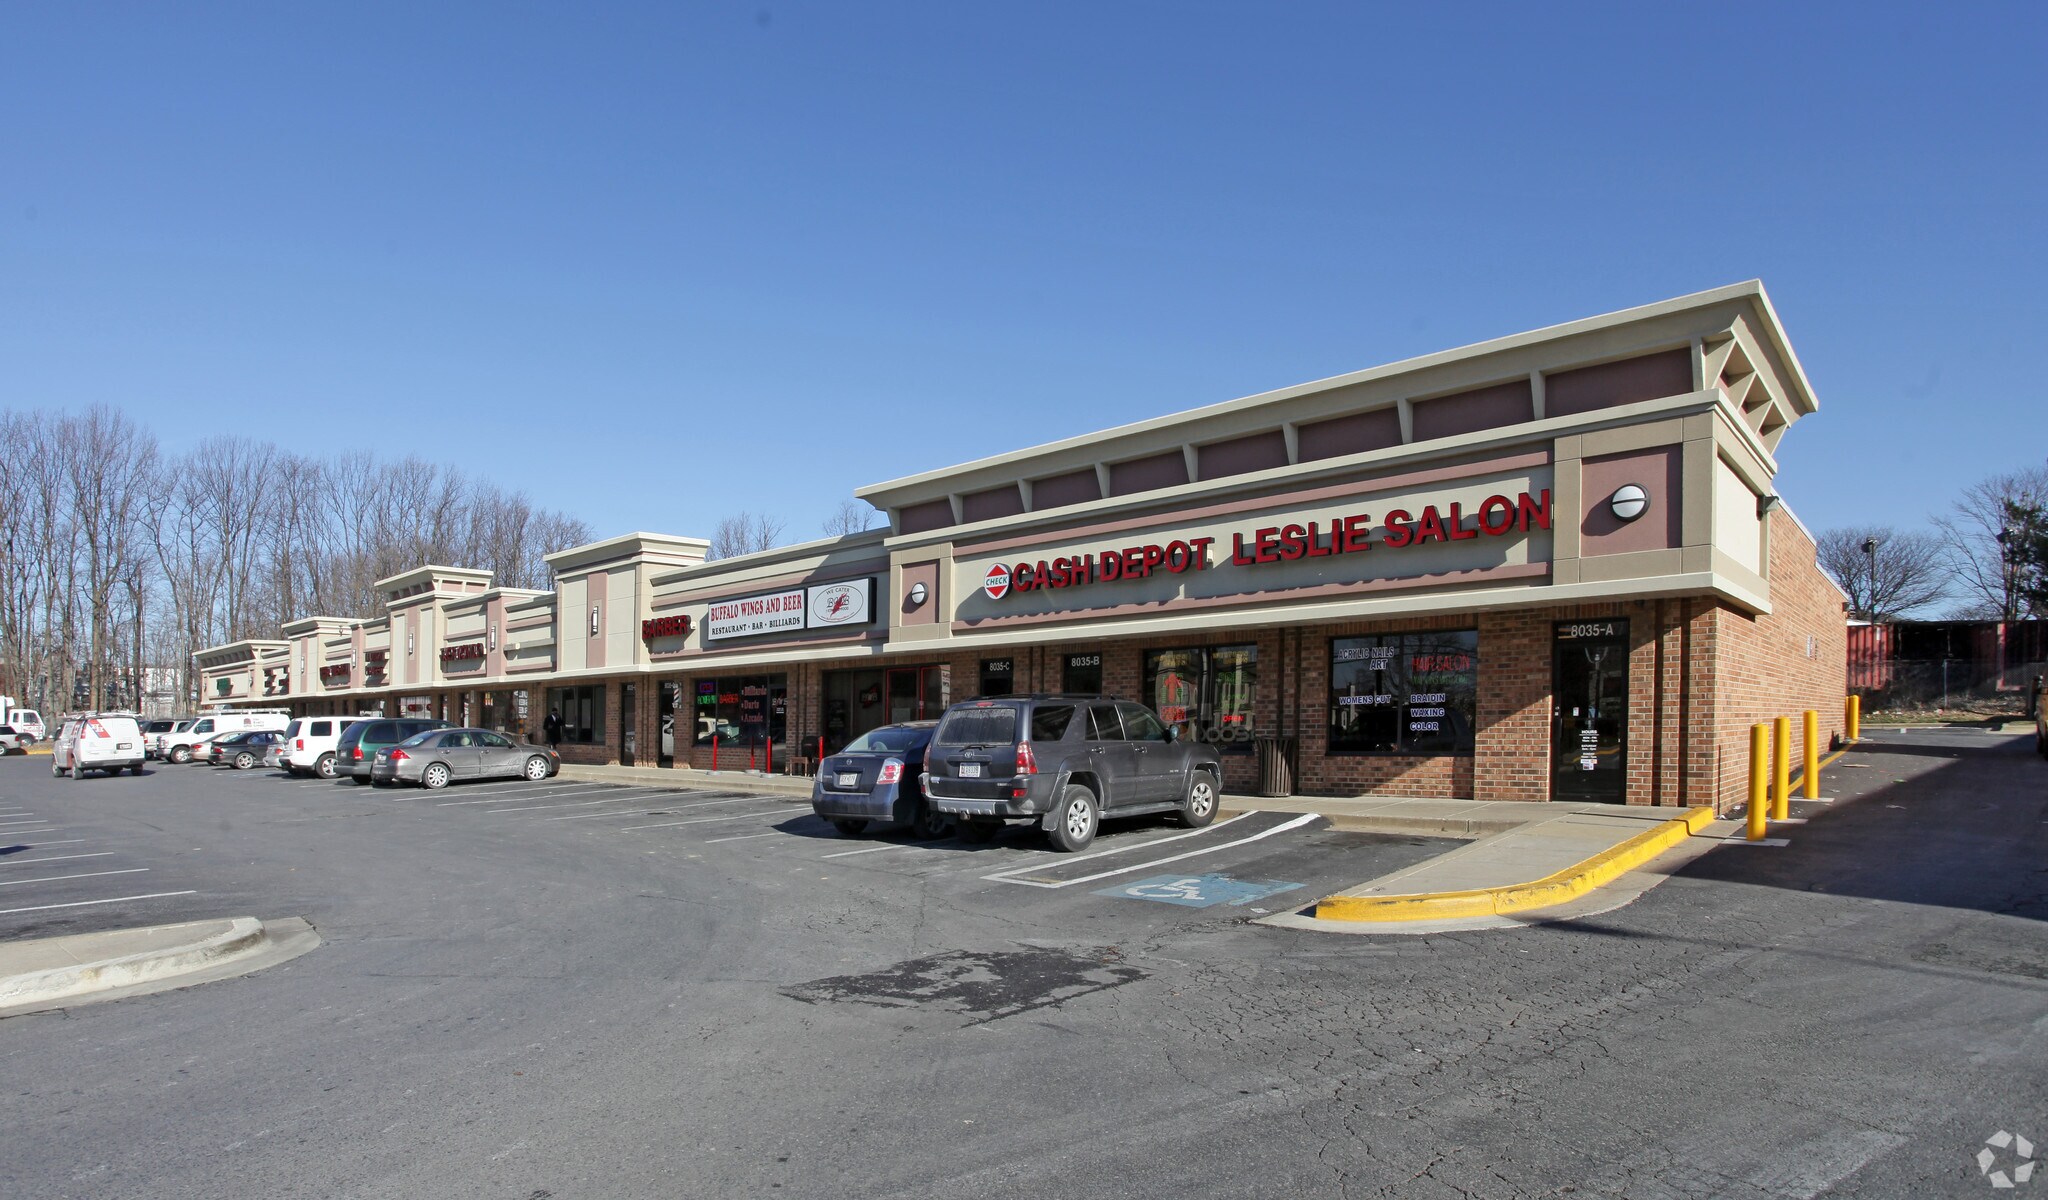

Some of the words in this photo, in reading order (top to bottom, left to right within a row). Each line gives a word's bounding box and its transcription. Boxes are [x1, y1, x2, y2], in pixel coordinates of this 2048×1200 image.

[1233, 514, 1370, 566] LESLIE
[1383, 489, 1550, 548] SALON
[1012, 554, 1093, 592] CASH
[1100, 537, 1214, 582] DEPOT
[986, 575, 1008, 587] CHECK
[711, 603, 739, 621] BUFFALO
[741, 600, 764, 618] WINGS
[765, 598, 781, 613] AND
[783, 594, 802, 610] BEER
[642, 615, 690, 639] BARBER
[712, 624, 747, 635] RESTAURANT
[752, 621, 764, 630] BAR
[769, 616, 800, 628] BILLIARDS
[1571, 623, 1614, 637] 8035-A
[1338, 647, 1370, 660] ACRYLIC
[1371, 646, 1395, 658] NAILS
[989, 661, 1010, 671] 8035-C
[1071, 656, 1100, 667] 8035-B
[1370, 659, 1388, 670] ART
[1436, 654, 1470, 672] SALON
[744, 701, 760, 709] Darts
[1339, 696, 1373, 705] WOMENS
[1374, 694, 1391, 704] CUT
[744, 713, 763, 722] Arcade
[1411, 708, 1445, 717] WAXING
[1223, 715, 1244, 723] OPEN
[1410, 722, 1439, 731] COLOR
